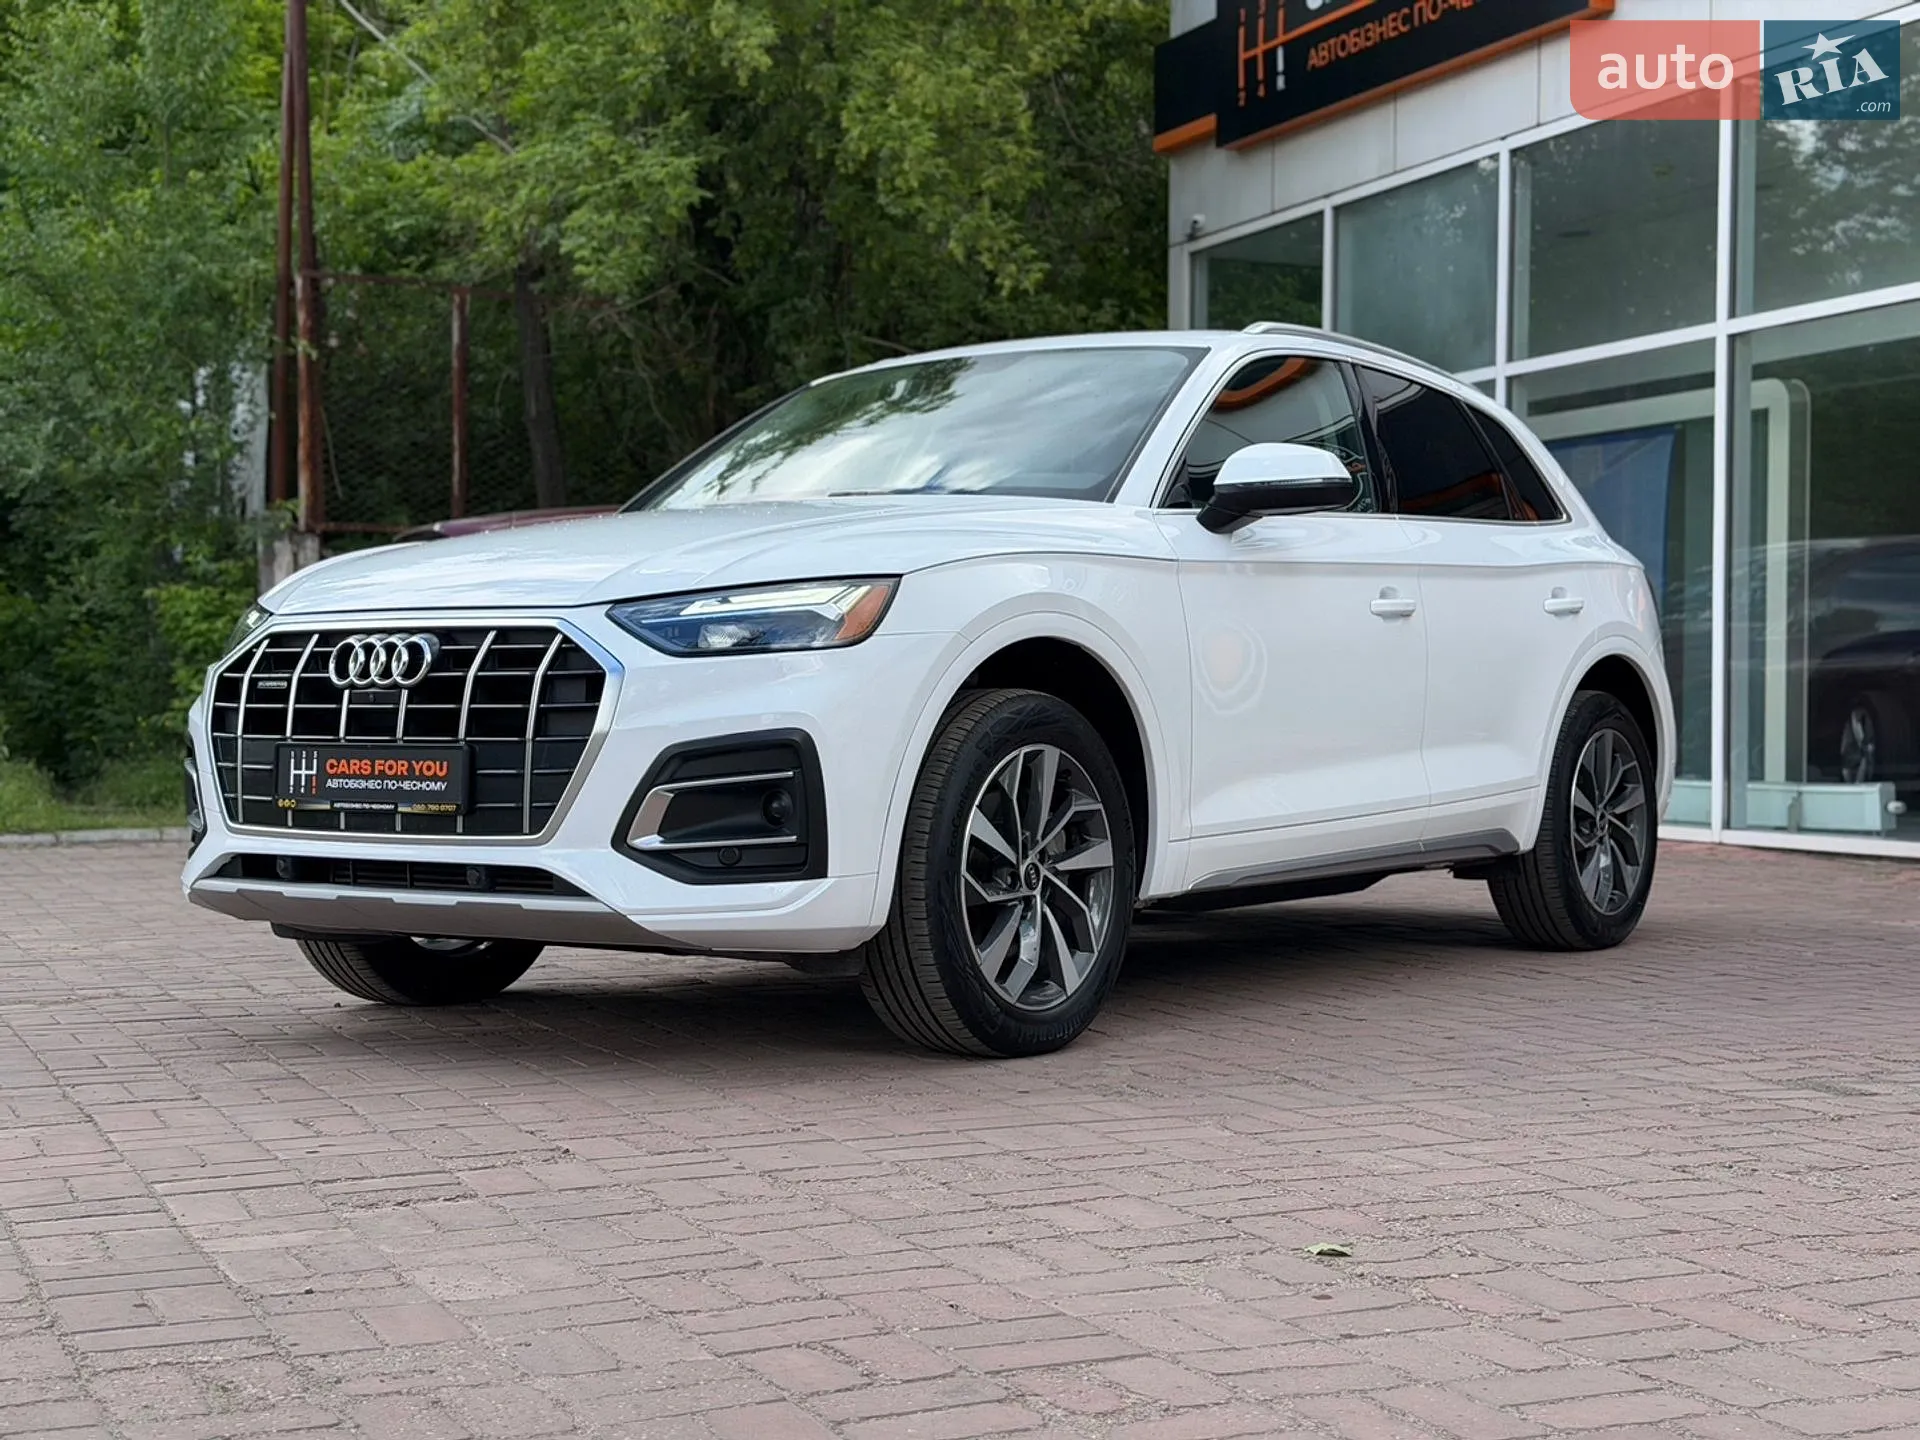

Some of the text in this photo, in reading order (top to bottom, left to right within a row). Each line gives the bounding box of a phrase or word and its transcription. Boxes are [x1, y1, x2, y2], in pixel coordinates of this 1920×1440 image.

[1306, 7, 1411, 71] АВТОБІЗНЕС
[326, 759, 448, 777] CARS FOR YOU
[325, 779, 448, 792] АВТОБІЗНЕС ПО-ЧЕСНОМУ
